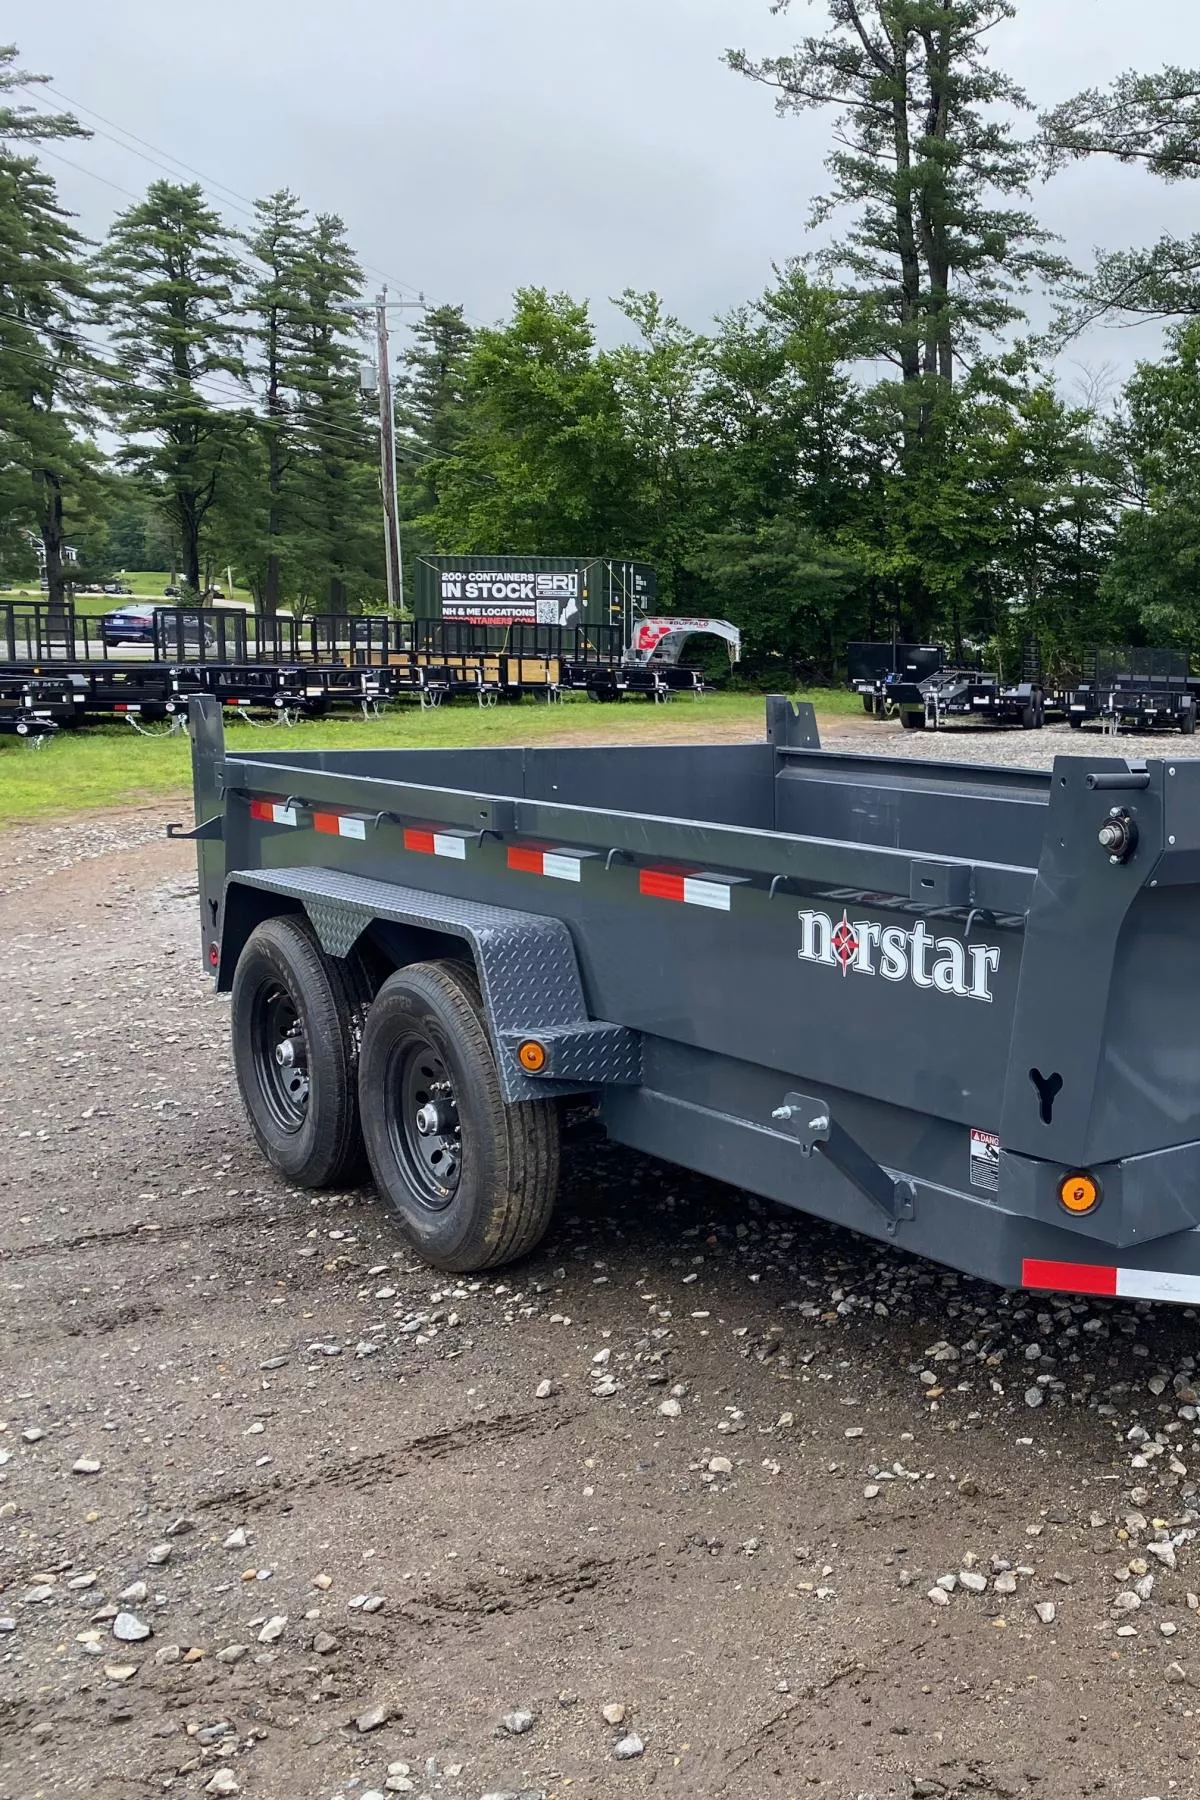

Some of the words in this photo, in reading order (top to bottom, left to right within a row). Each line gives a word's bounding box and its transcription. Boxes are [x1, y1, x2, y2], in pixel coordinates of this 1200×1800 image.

[441, 572, 466, 581] 200+
[468, 573, 535, 582] CONTAINERS
[441, 582, 461, 598] IN
[465, 583, 535, 599] STOCK
[442, 608, 456, 616] NH
[457, 608, 465, 616] &
[466, 608, 480, 616] ME
[482, 608, 535, 617] LOCATIONS
[797, 908, 1001, 1003] norstar
[980, 1133, 999, 1146] DANG
